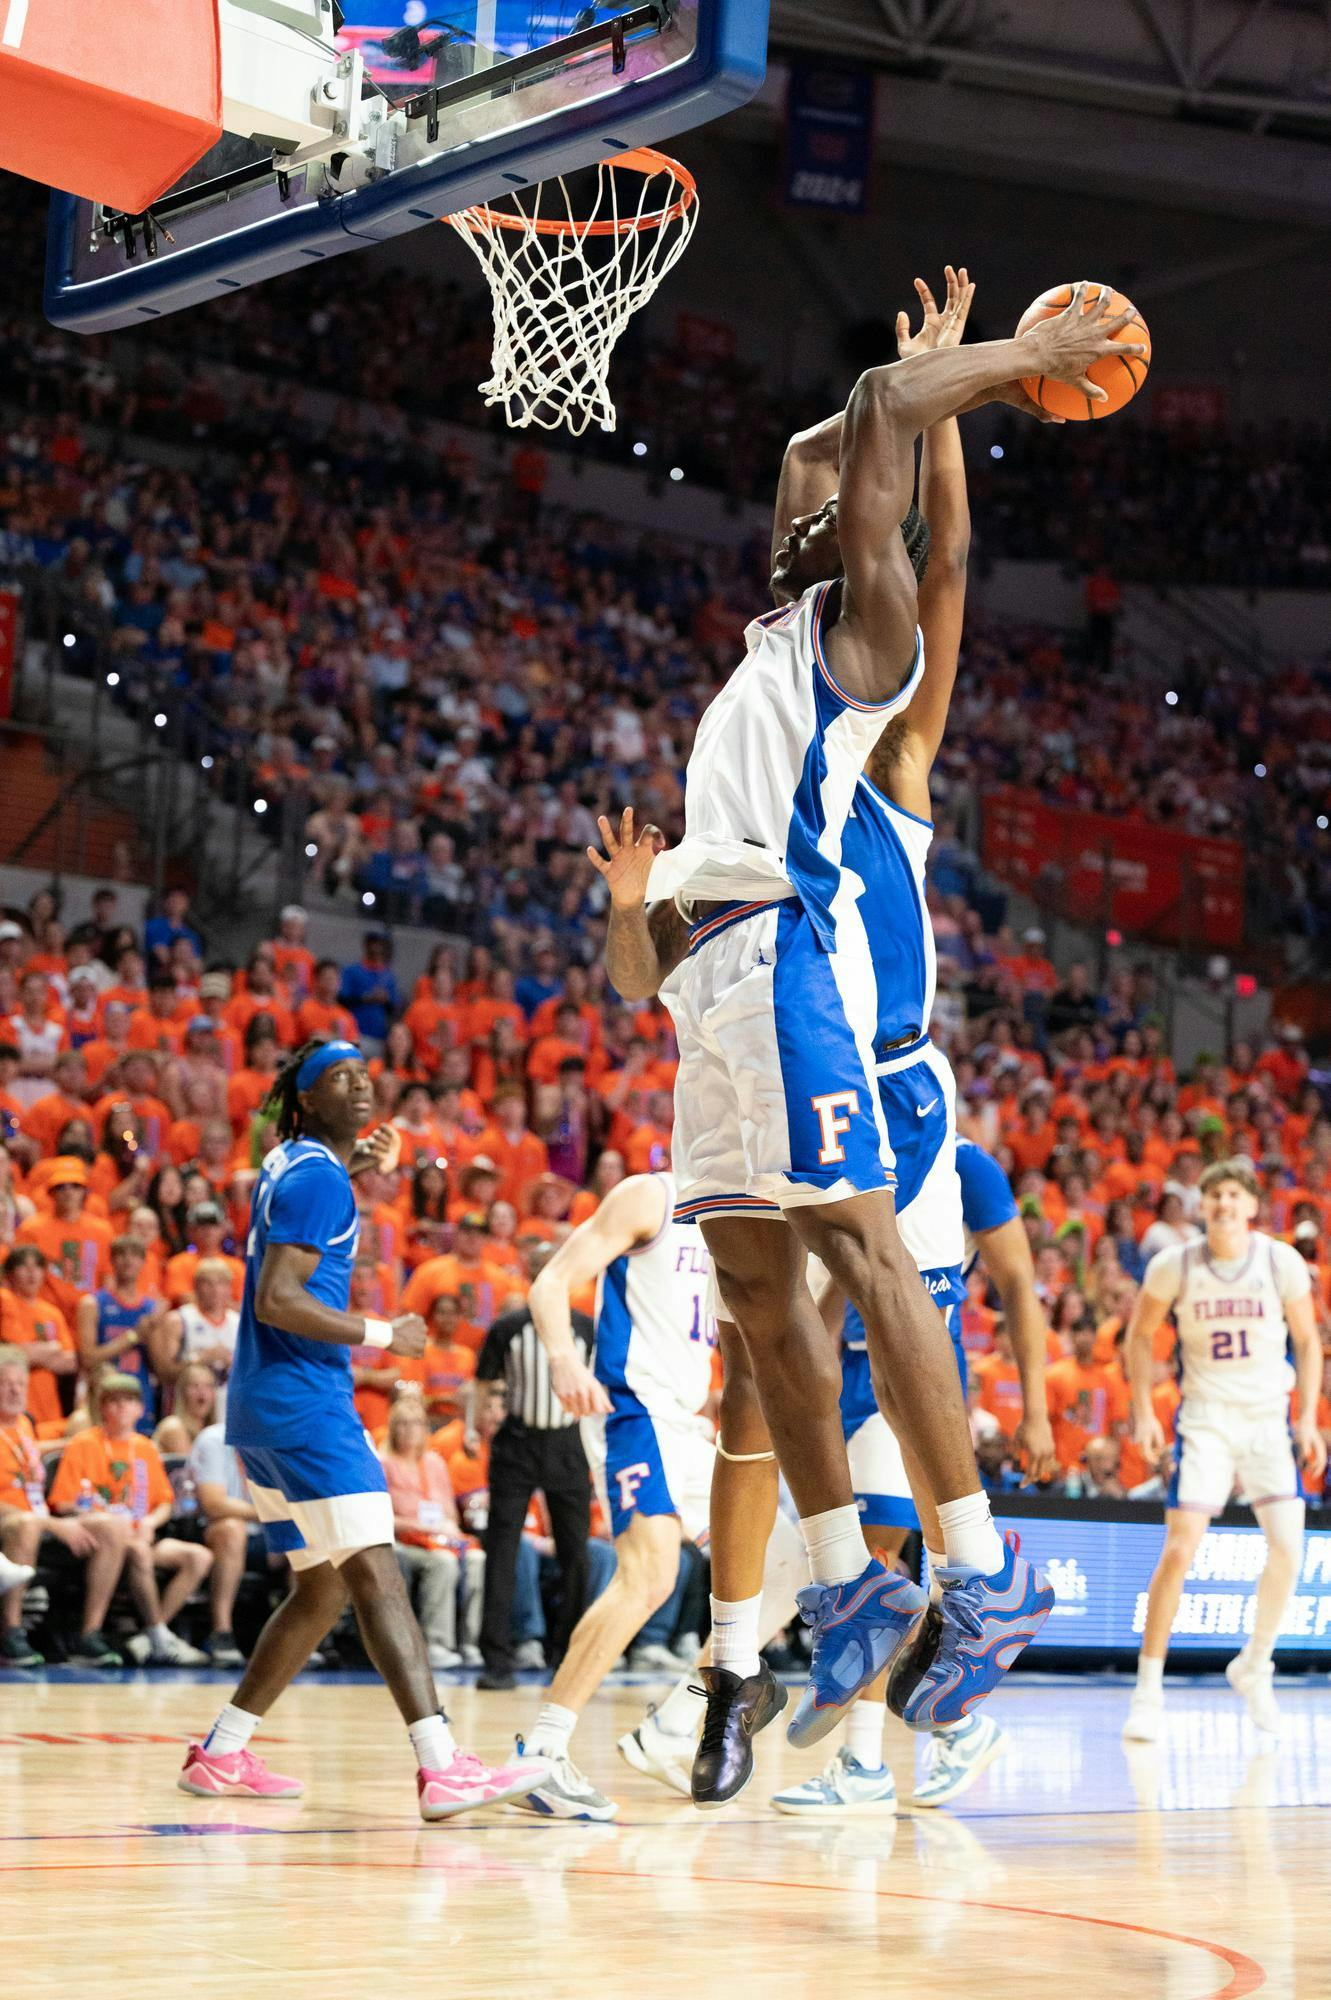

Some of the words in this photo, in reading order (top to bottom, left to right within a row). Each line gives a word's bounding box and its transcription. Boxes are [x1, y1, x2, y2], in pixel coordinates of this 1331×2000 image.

[811, 1090, 860, 1165] F
[1194, 1299, 1264, 1321] FLORIDA
[1211, 1329, 1250, 1360] 21
[615, 1462, 651, 1511] F
